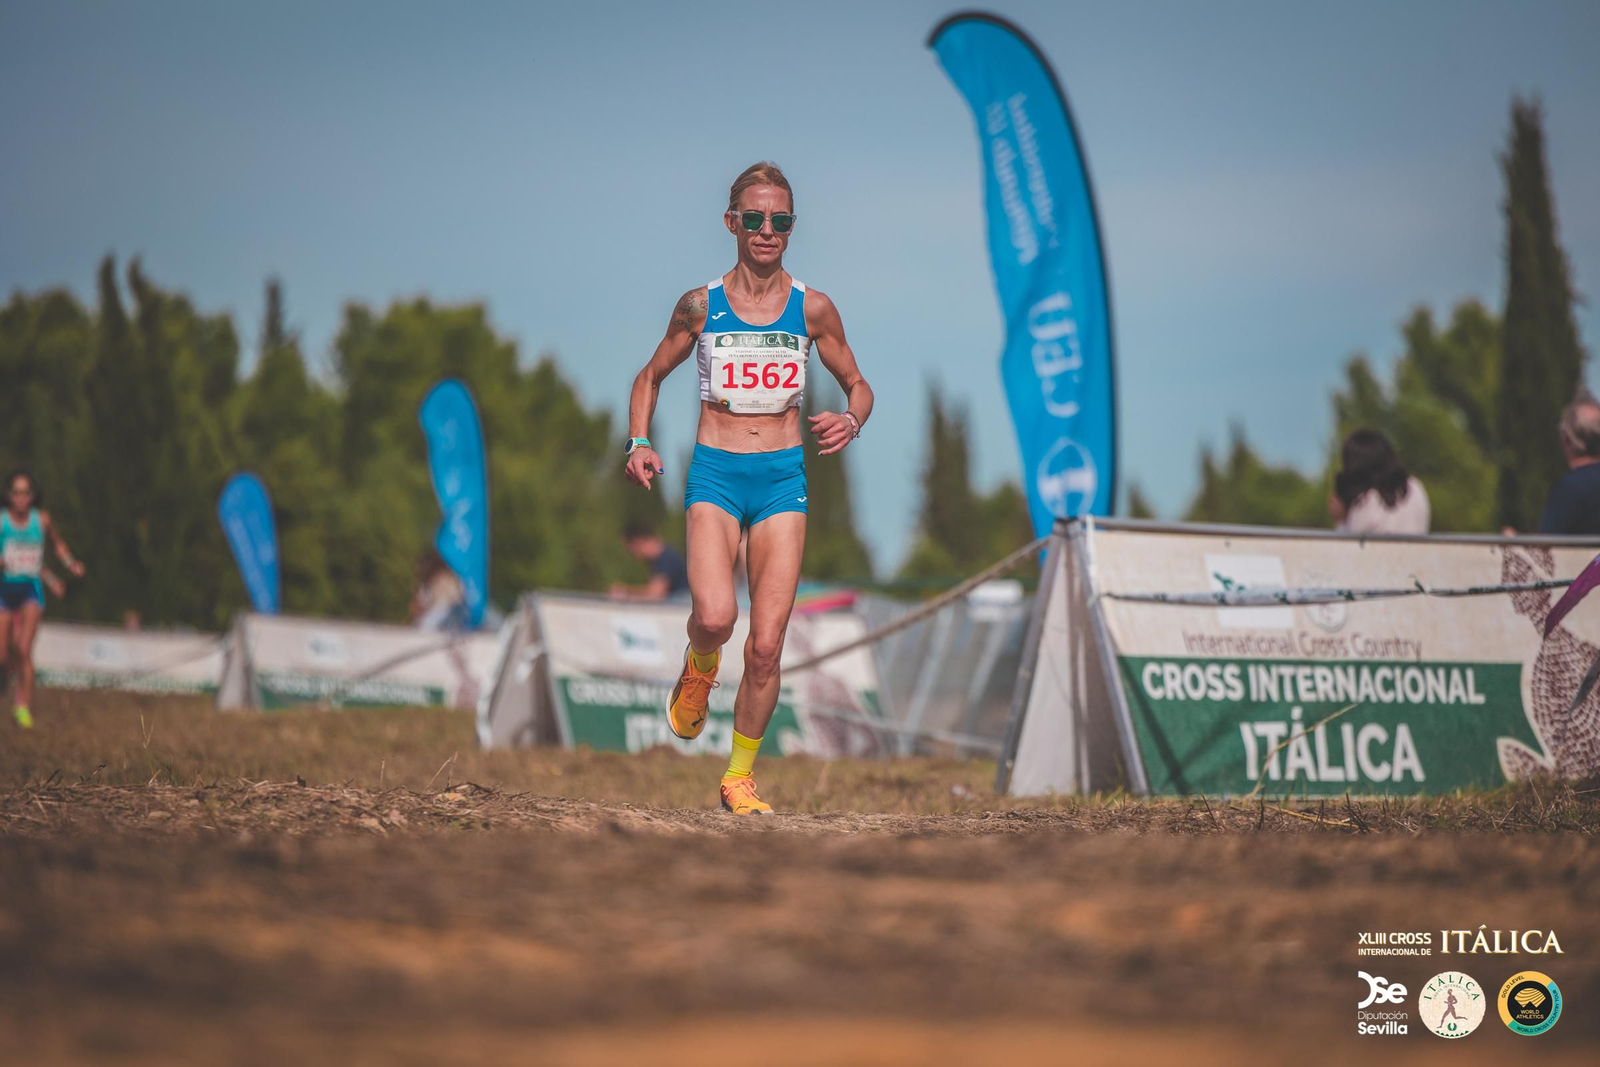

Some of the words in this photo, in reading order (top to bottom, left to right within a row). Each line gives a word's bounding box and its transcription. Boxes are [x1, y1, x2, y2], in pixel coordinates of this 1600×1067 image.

[722, 363, 799, 389] 1562
[1182, 631, 1296, 657] International
[1298, 632, 1348, 657] Cross
[1350, 632, 1422, 663] Country
[1141, 662, 1246, 702] CROSS
[1247, 664, 1486, 705] INTERNACIONAL
[1239, 706, 1426, 783] ITÁLICA
